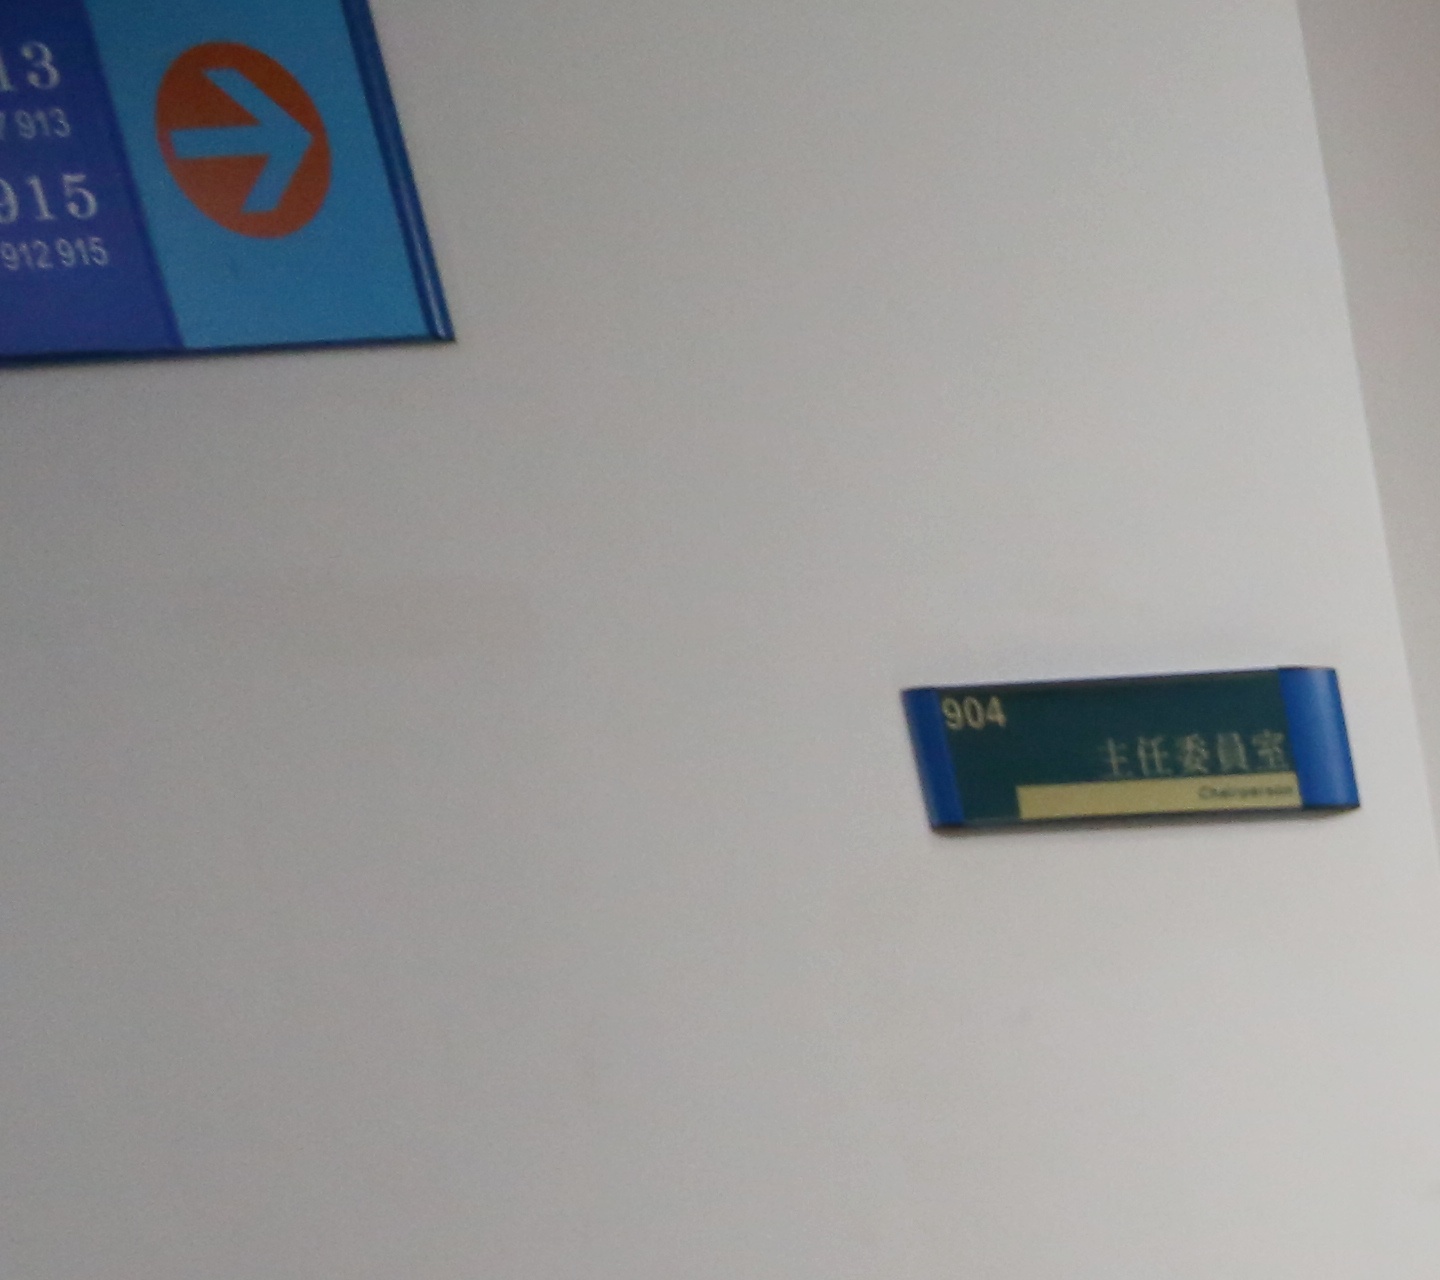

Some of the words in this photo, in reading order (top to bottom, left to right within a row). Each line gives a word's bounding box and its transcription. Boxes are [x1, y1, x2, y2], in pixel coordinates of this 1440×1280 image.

[941, 696, 1007, 731] 904
[1100, 729, 1288, 778] 主任委員室
